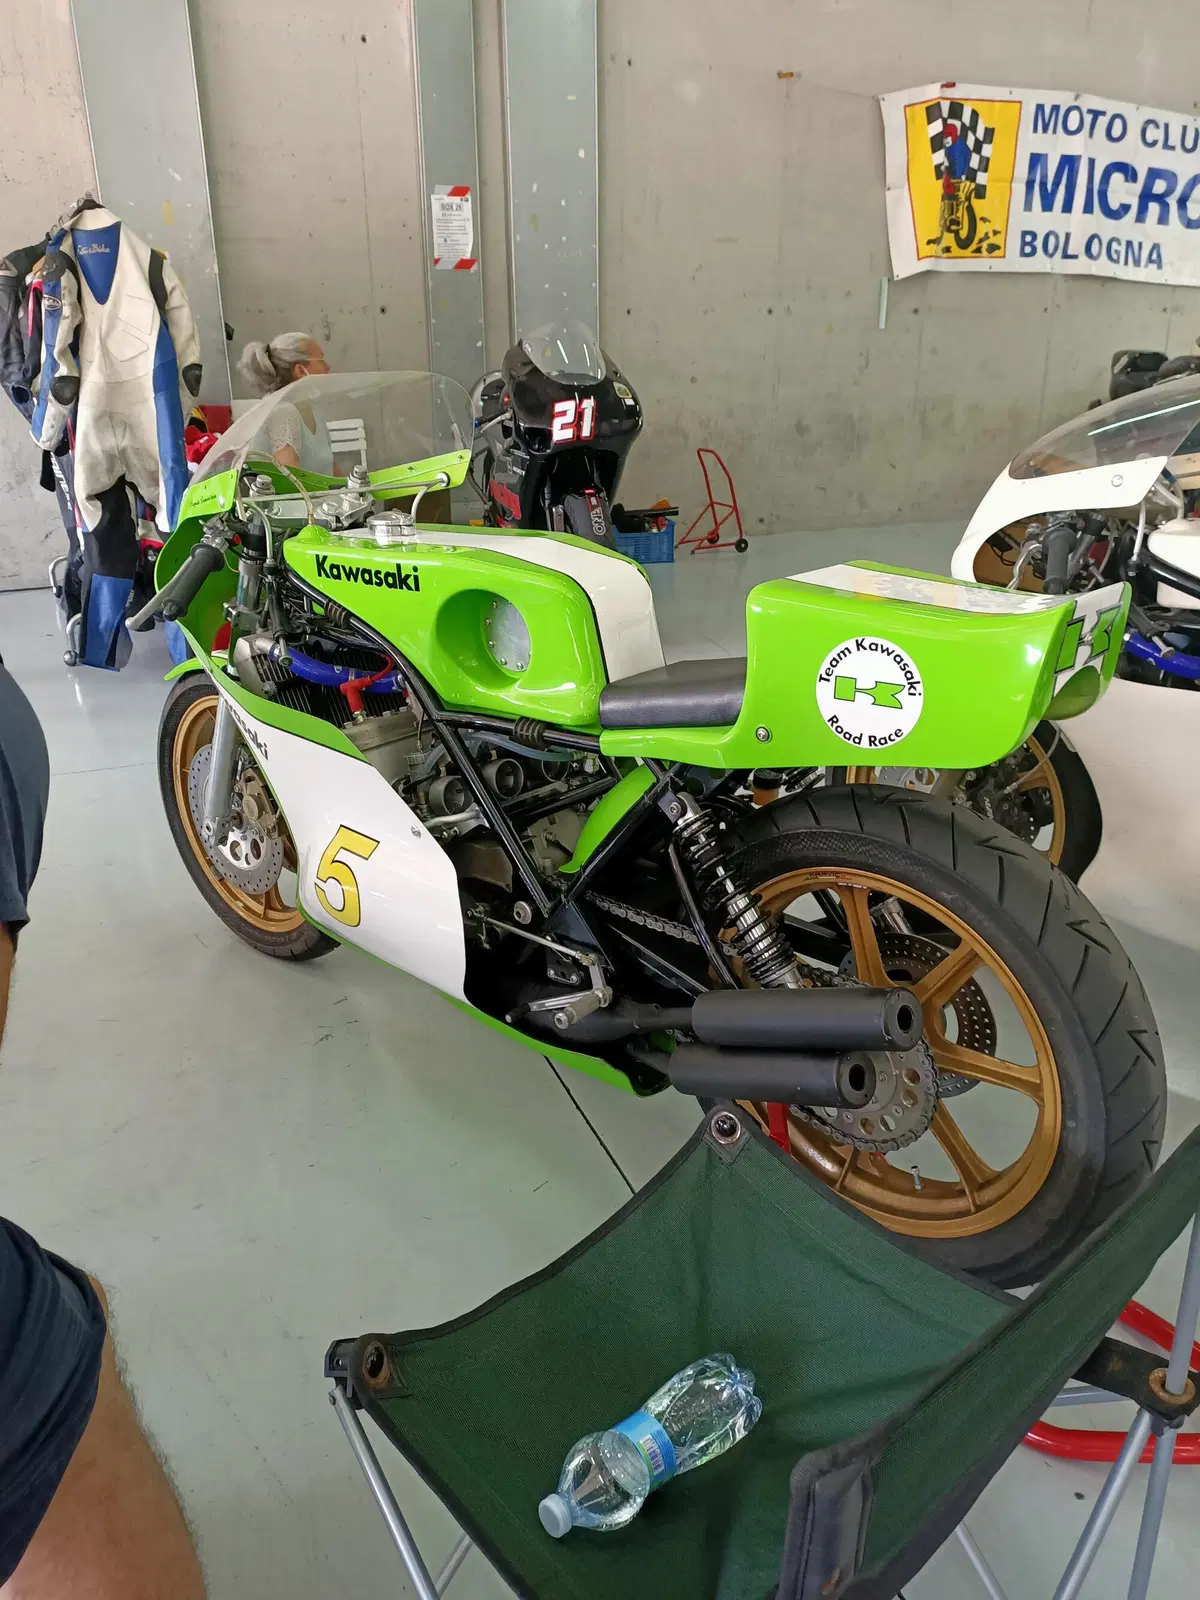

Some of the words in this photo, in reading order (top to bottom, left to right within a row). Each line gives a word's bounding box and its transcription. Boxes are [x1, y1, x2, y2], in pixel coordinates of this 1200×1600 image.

[1032, 103, 1128, 143] MOTO
[1019, 230, 1163, 270] BOLOGNA
[552, 398, 597, 443] 21
[315, 553, 421, 592] Kawasaki
[818, 647, 852, 683] Team
[855, 638, 922, 696] Kawasaki
[827, 714, 863, 745] Road
[868, 728, 904, 747] Race
[314, 824, 381, 927] 5
